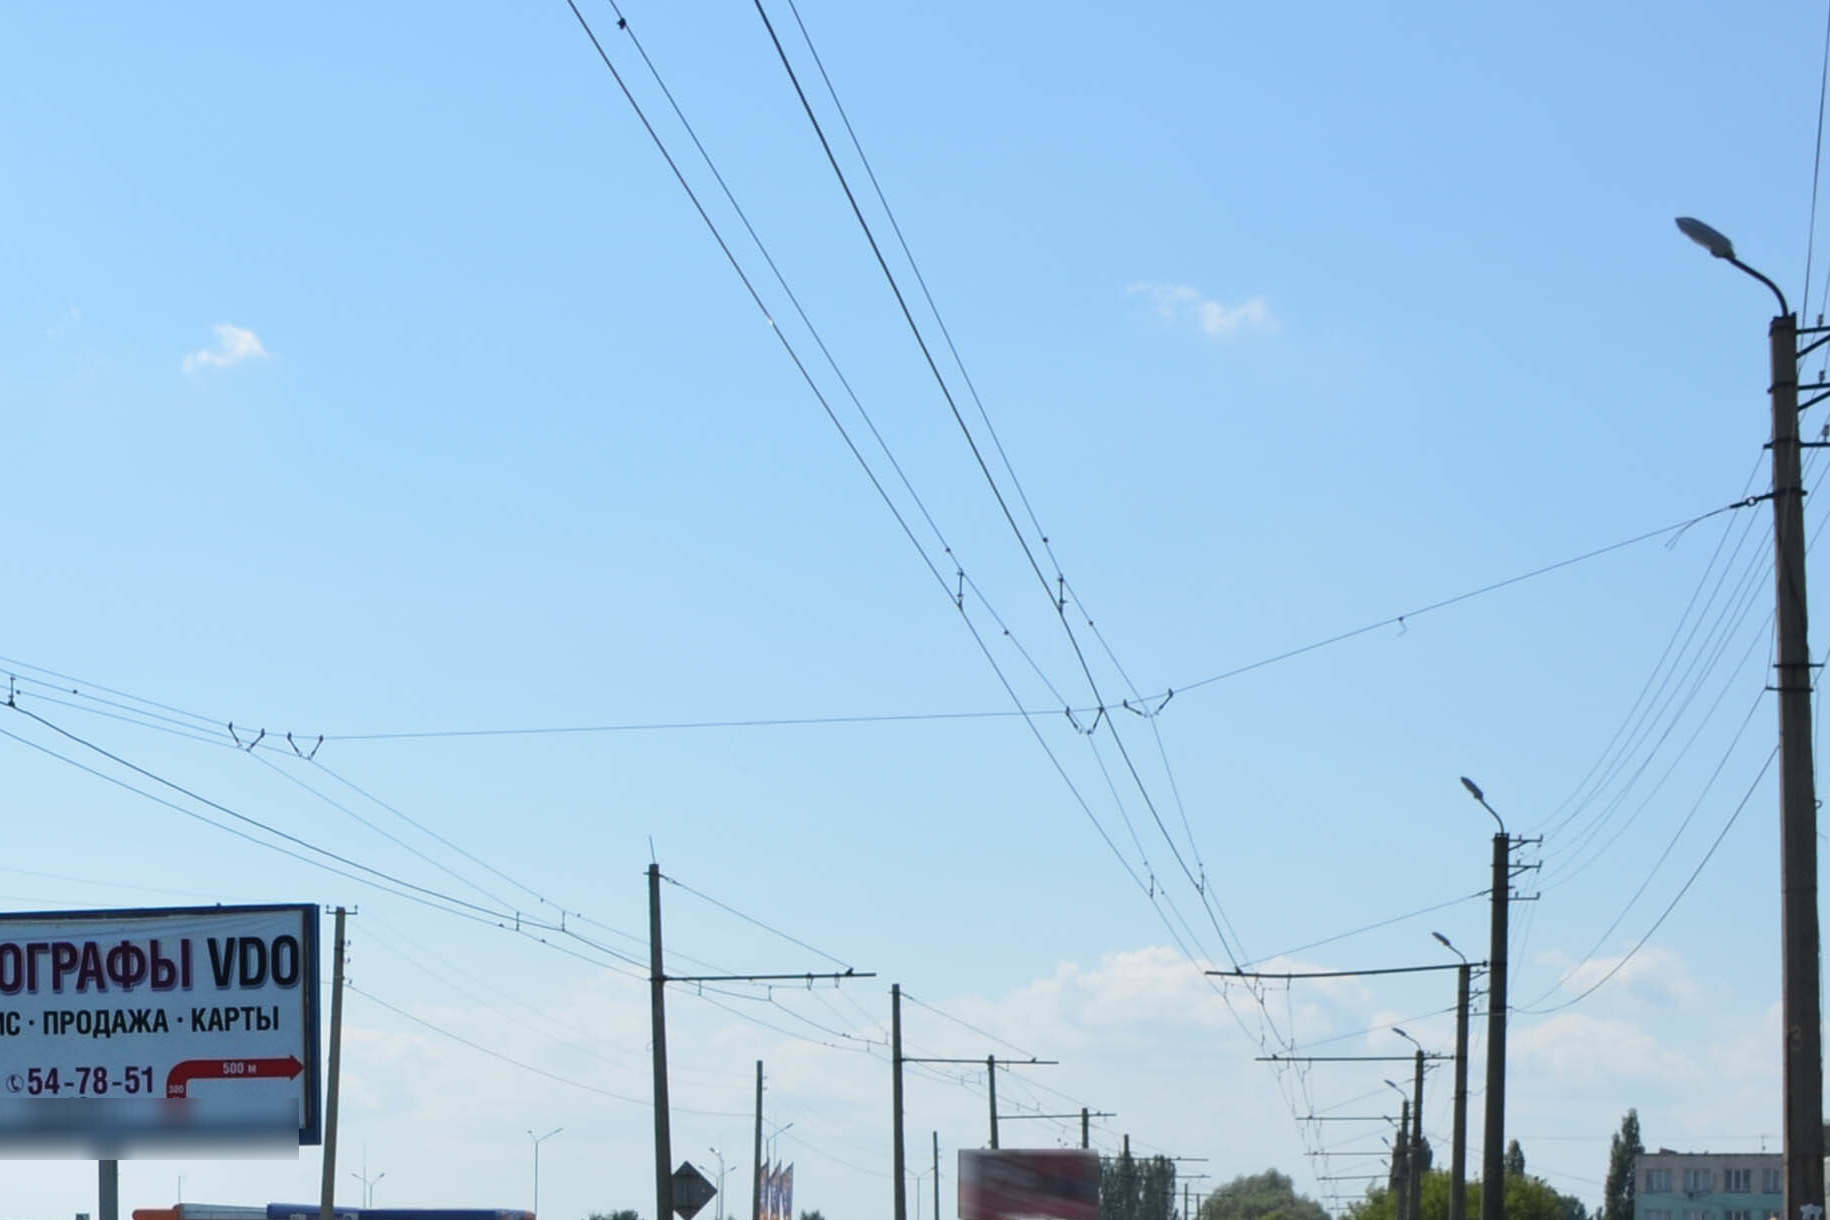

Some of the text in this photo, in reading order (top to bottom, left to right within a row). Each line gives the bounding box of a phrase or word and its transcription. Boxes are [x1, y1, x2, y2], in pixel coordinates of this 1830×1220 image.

[206, 934, 300, 989] VDO
[43, 1008, 169, 1038] ПРОДАЖА
[191, 1006, 279, 1032] КАРТЫ
[27, 1066, 153, 1095] 54-78-51
[223, 1062, 244, 1074] 500
